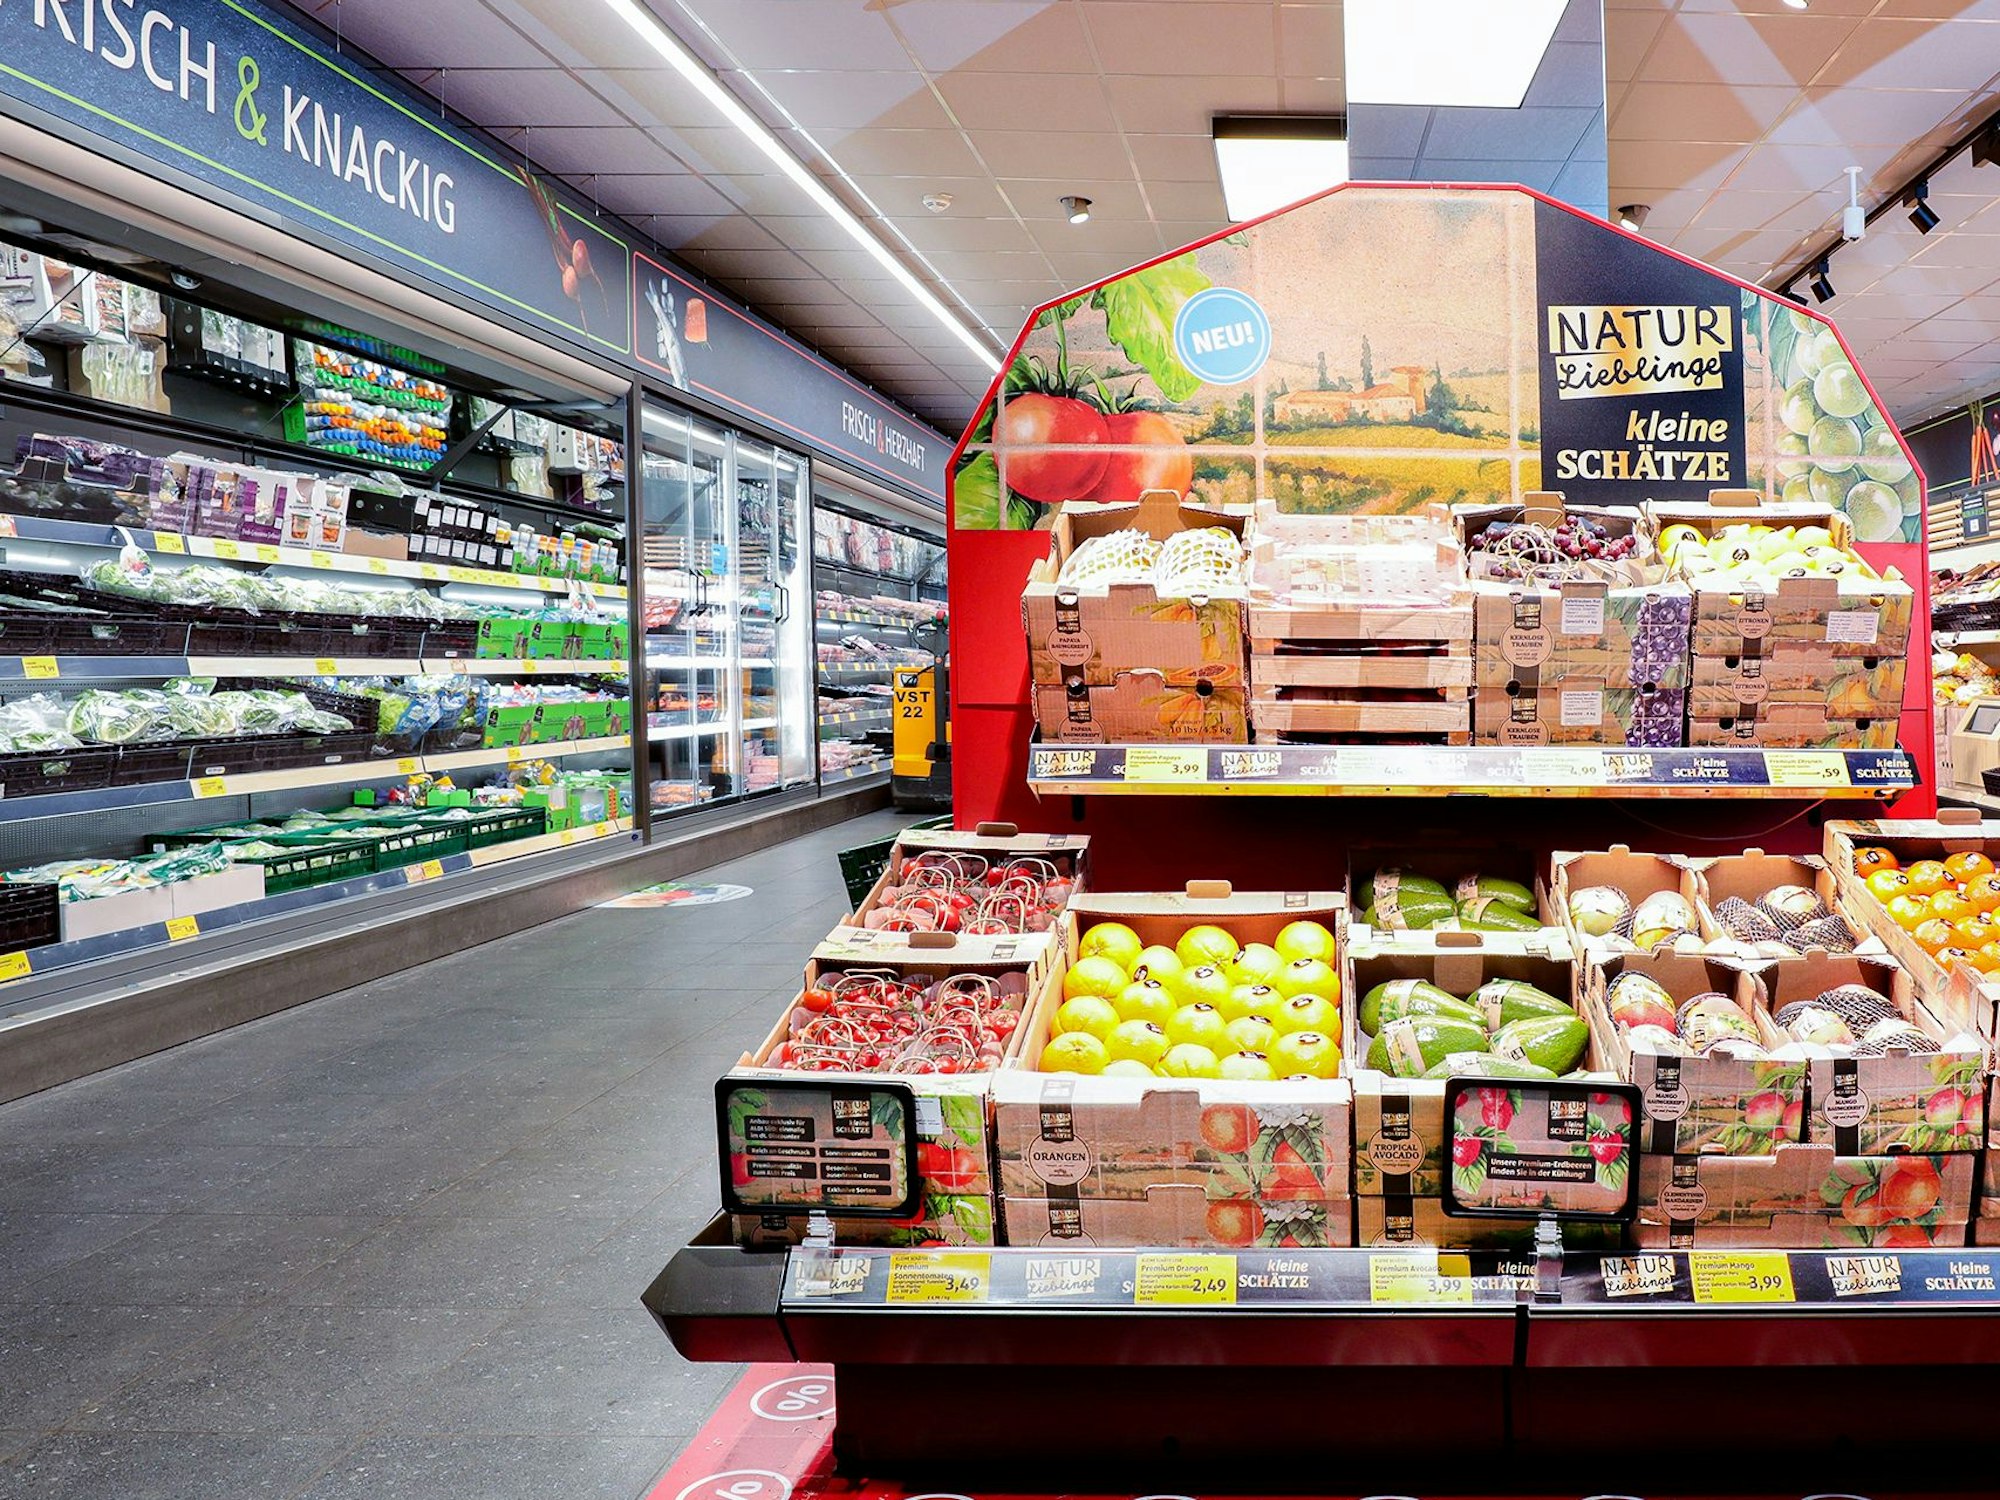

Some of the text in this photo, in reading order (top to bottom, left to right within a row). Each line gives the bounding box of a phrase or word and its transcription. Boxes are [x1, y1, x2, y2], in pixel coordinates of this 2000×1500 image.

[233, 56, 268, 146] &
[283, 84, 456, 234] KNACKIG
[1557, 305, 1726, 354] NATUR
[1191, 321, 1255, 355] NEU!
[1558, 355, 1722, 390] Lieblinge
[1626, 410, 1729, 442] kleine
[842, 400, 925, 472] FRISCH & HERZHAFT
[1556, 444, 1730, 482] SCHÄTZE
[895, 691, 931, 703] VST
[902, 706, 924, 718] 22
[1037, 751, 1094, 765] NATUR
[1224, 752, 1280, 766] NATUR
[1693, 758, 1727, 767] kleine
[1876, 758, 1910, 768] kleine
[1172, 764, 1200, 775] 3,99
[1672, 766, 1729, 778] SCHÄTZE
[1855, 768, 1914, 779] SCHÄTZE
[834, 1100, 870, 1110] NATUR
[1550, 1101, 1586, 1111] NATUR
[835, 1126, 871, 1134] SCHÄTZE
[1550, 1127, 1585, 1136] SCHÄTZE
[1374, 1143, 1418, 1151] TROPICAL
[1033, 1152, 1087, 1161] ORANGEN
[1372, 1151, 1420, 1160] AVOCADO
[1490, 1158, 1592, 1169] Unsere Premium-Erdbeeren
[1490, 1167, 1586, 1179] finden Sie in der Kühlung!
[799, 1256, 867, 1278] NATUR
[1029, 1258, 1097, 1279] NATUR
[1176, 1265, 1209, 1273] Orangen
[1267, 1259, 1309, 1273] kleine
[1497, 1261, 1537, 1275] kleine
[1603, 1256, 1673, 1277] NATUR
[1829, 1256, 1897, 1277] NATUR
[1949, 1262, 1991, 1275] kleine
[945, 1276, 980, 1293] 3,49
[1028, 1278, 1096, 1295] Lieblinge
[1192, 1278, 1226, 1294] 2,49
[1238, 1272, 1309, 1289] SCHÄTZE
[1428, 1279, 1462, 1294] 3,99
[1471, 1275, 1541, 1291] SCHÄTZE
[1605, 1275, 1673, 1292] Lieblinge
[1748, 1275, 1782, 1291] 3,99
[1834, 1275, 1900, 1292] Lieblinge
[1925, 1276, 1996, 1291] SCHÄTZE
